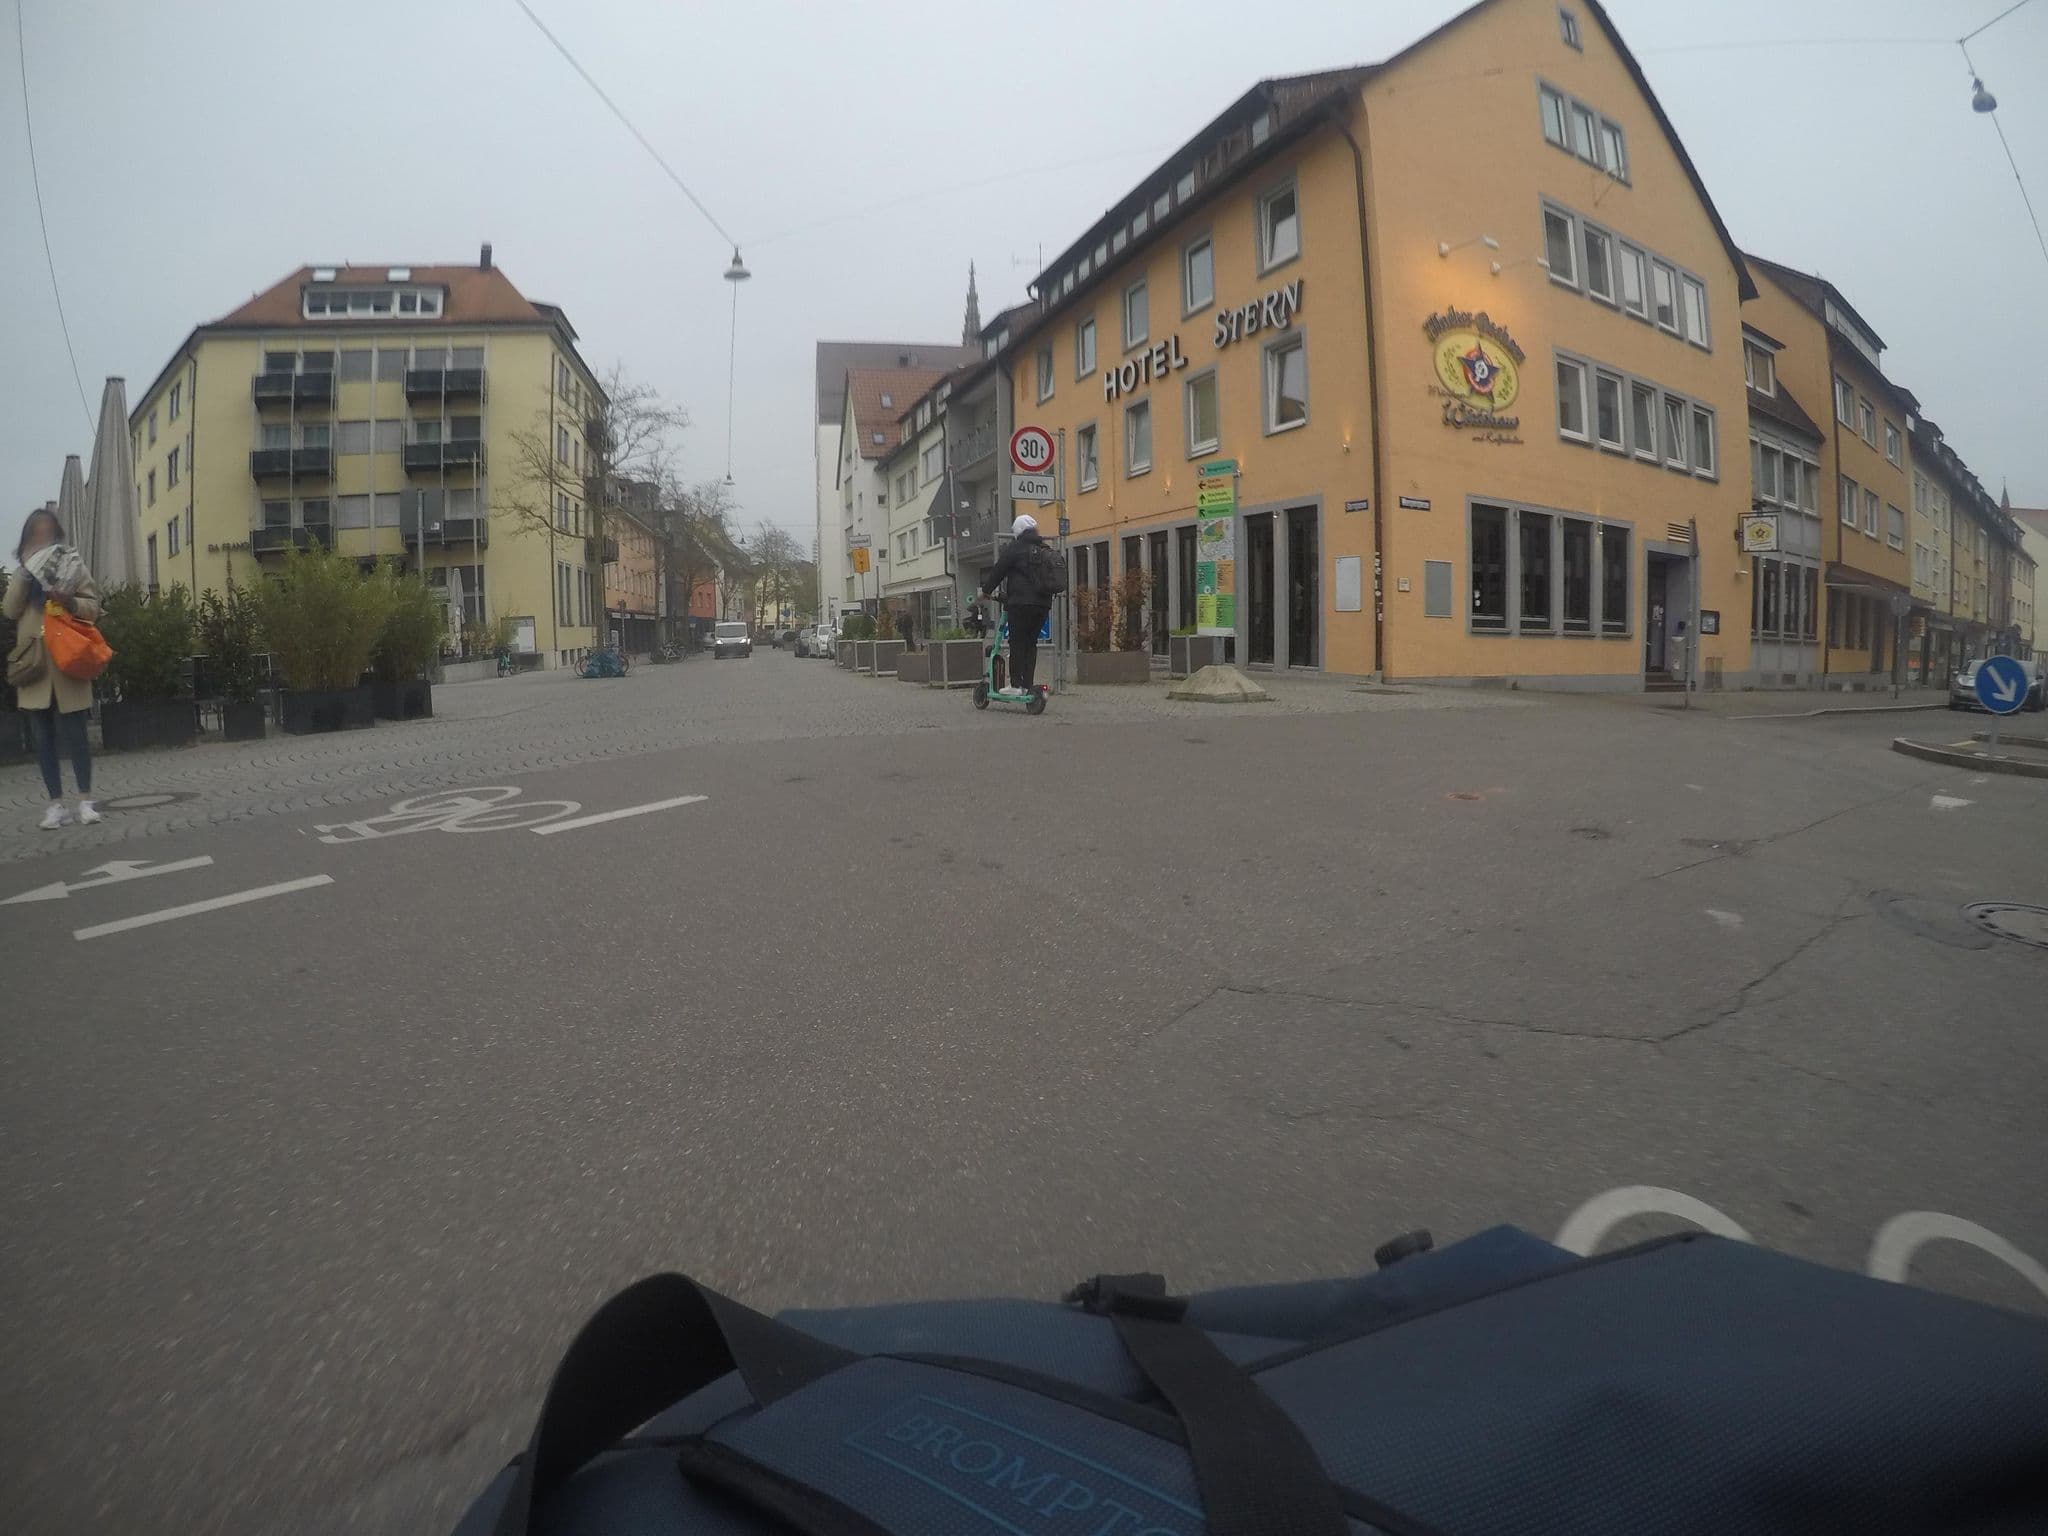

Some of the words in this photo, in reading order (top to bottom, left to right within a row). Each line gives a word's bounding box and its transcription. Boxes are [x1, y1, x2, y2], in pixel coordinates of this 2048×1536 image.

[1103, 333, 1188, 403] HOTEL
[1213, 277, 1304, 350] STERN
[887, 1416, 1181, 1536] BROMPT
